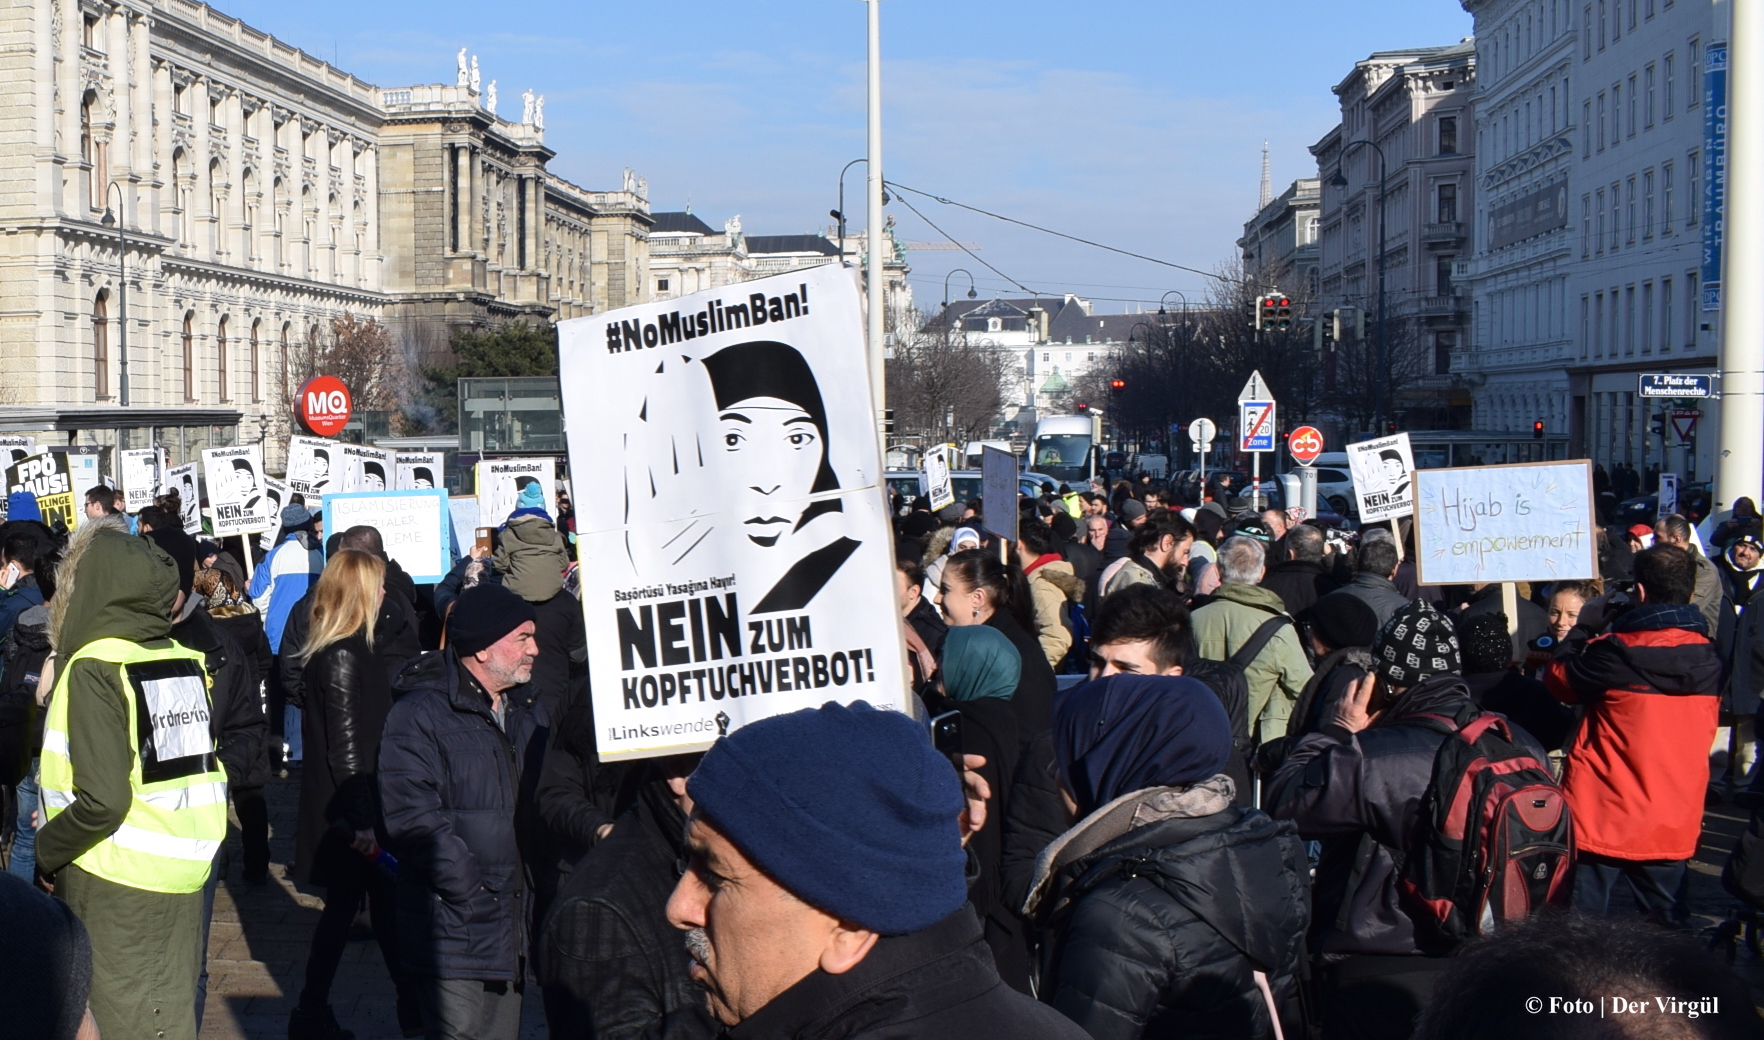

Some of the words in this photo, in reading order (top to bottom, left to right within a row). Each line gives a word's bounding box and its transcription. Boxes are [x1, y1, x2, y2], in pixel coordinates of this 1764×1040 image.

[1705, 90, 1713, 126] IHR
[1704, 138, 1713, 212] HABEN
[1704, 224, 1712, 265] WIR
[606, 283, 810, 354] #NoMuslimBan!
[1663, 376, 1683, 386] Platz
[1684, 376, 1699, 386] der
[1644, 385, 1707, 396] Menschenrechte
[307, 390, 349, 415] MQ
[1259, 425, 1270, 435] 20
[1247, 438, 1269, 447] Zone
[343, 447, 387, 461] #NoMuslimBan!
[17, 452, 57, 484] FPÖ
[490, 463, 542, 474] #NoMuslimBan!
[39, 495, 71, 509] TLINGE
[129, 490, 148, 500] NEIN
[1363, 492, 1390, 508] NEIN
[1391, 495, 1403, 503] ZUM
[216, 504, 242, 520] NEIN
[243, 509, 255, 517] ZUM
[337, 499, 439, 515] ISLAMISIERUNG
[1365, 499, 1413, 514] KOPFTUCHVERBOT
[1441, 487, 1502, 532] Hijab
[1515, 493, 1531, 515] is
[42, 504, 73, 527] IN!
[218, 516, 266, 528] KOPFTUCHVERBOT!
[385, 531, 423, 547] LEME
[614, 583, 664, 605] Başörtüsü
[665, 579, 709, 596] Yasağına
[616, 591, 742, 671] NEIN
[747, 615, 813, 655] ZUM
[621, 648, 876, 710] KOPFTUCHVERBOT!
[612, 717, 714, 741] Linkswende
